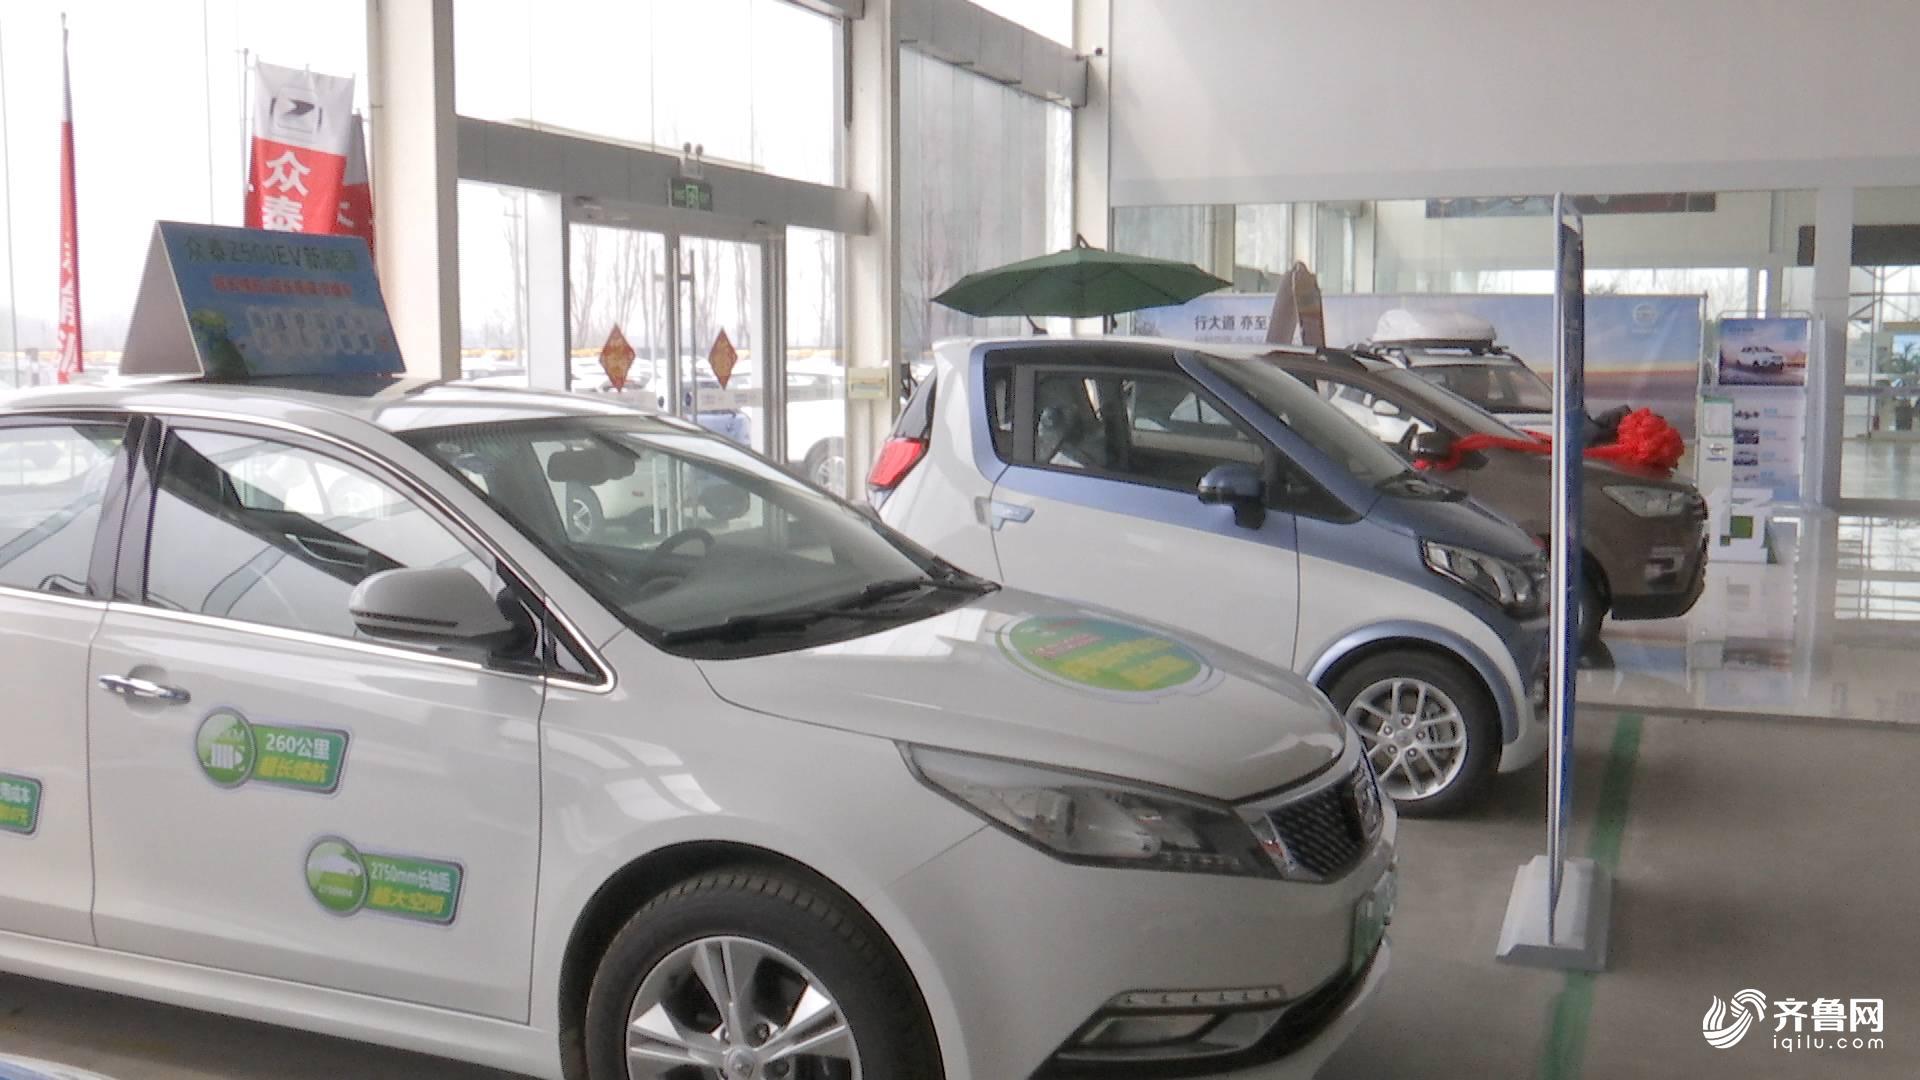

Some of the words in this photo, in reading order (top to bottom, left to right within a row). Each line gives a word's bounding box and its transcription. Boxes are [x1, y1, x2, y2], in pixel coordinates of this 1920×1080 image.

[262, 150, 312, 232] 众泰
[1194, 315, 1235, 331] 行大道
[1240, 315, 1270, 331] 亦至
[265, 733, 330, 761] 260公里
